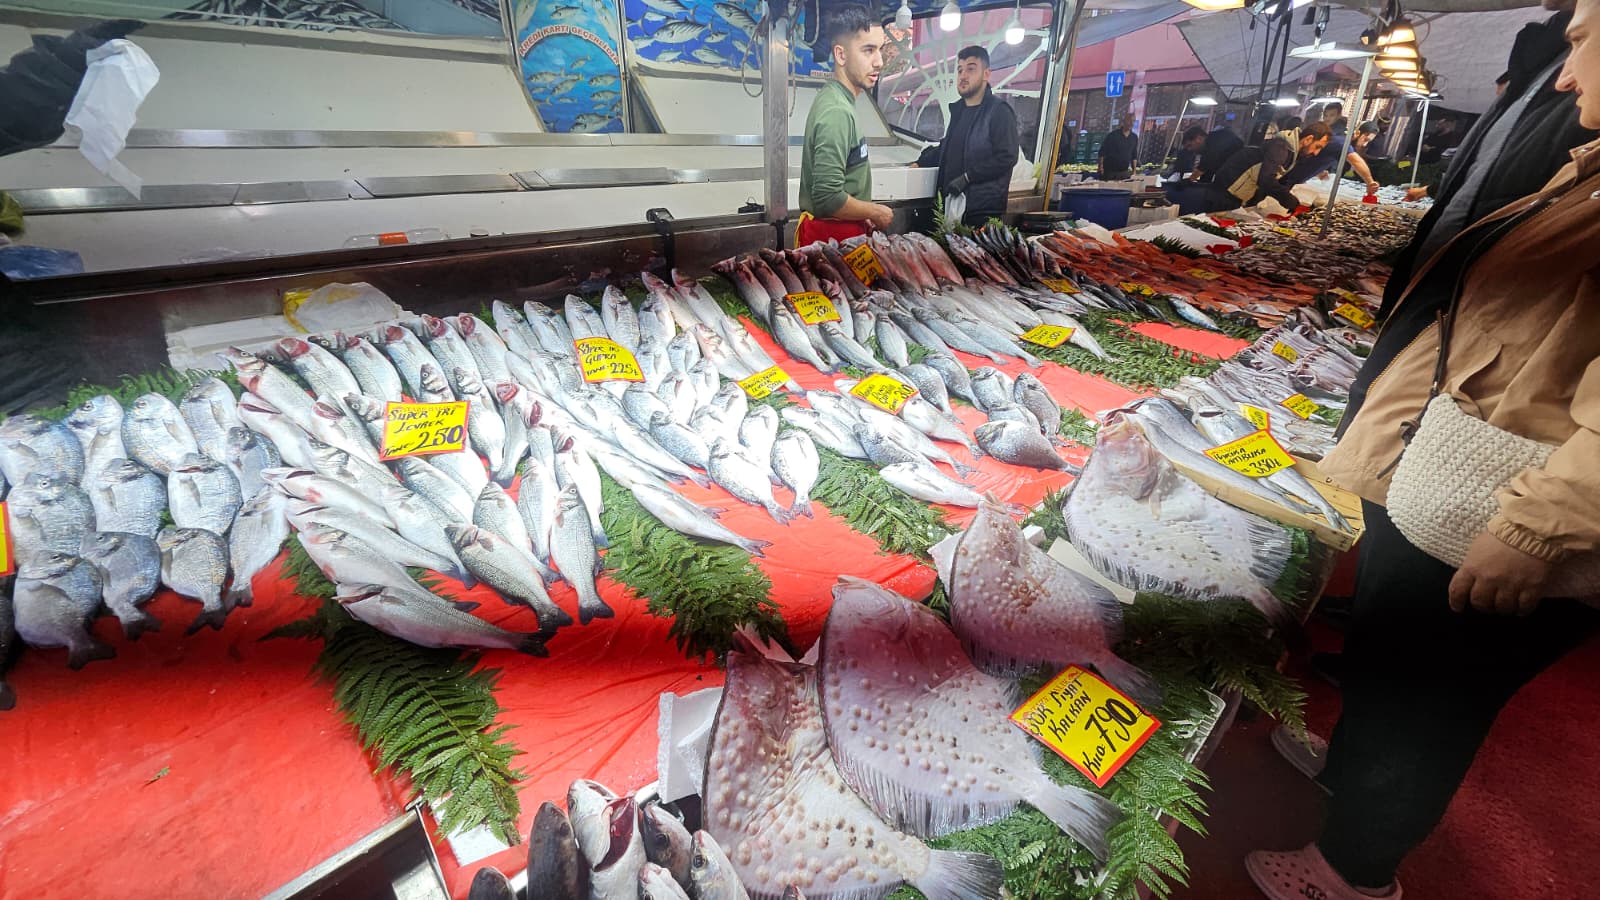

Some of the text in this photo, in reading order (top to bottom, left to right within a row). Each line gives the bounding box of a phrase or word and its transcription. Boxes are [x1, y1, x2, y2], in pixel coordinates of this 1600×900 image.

[543, 25, 569, 34] KARTI
[408, 425, 464, 452] 250
[1084, 698, 1138, 753] 790
